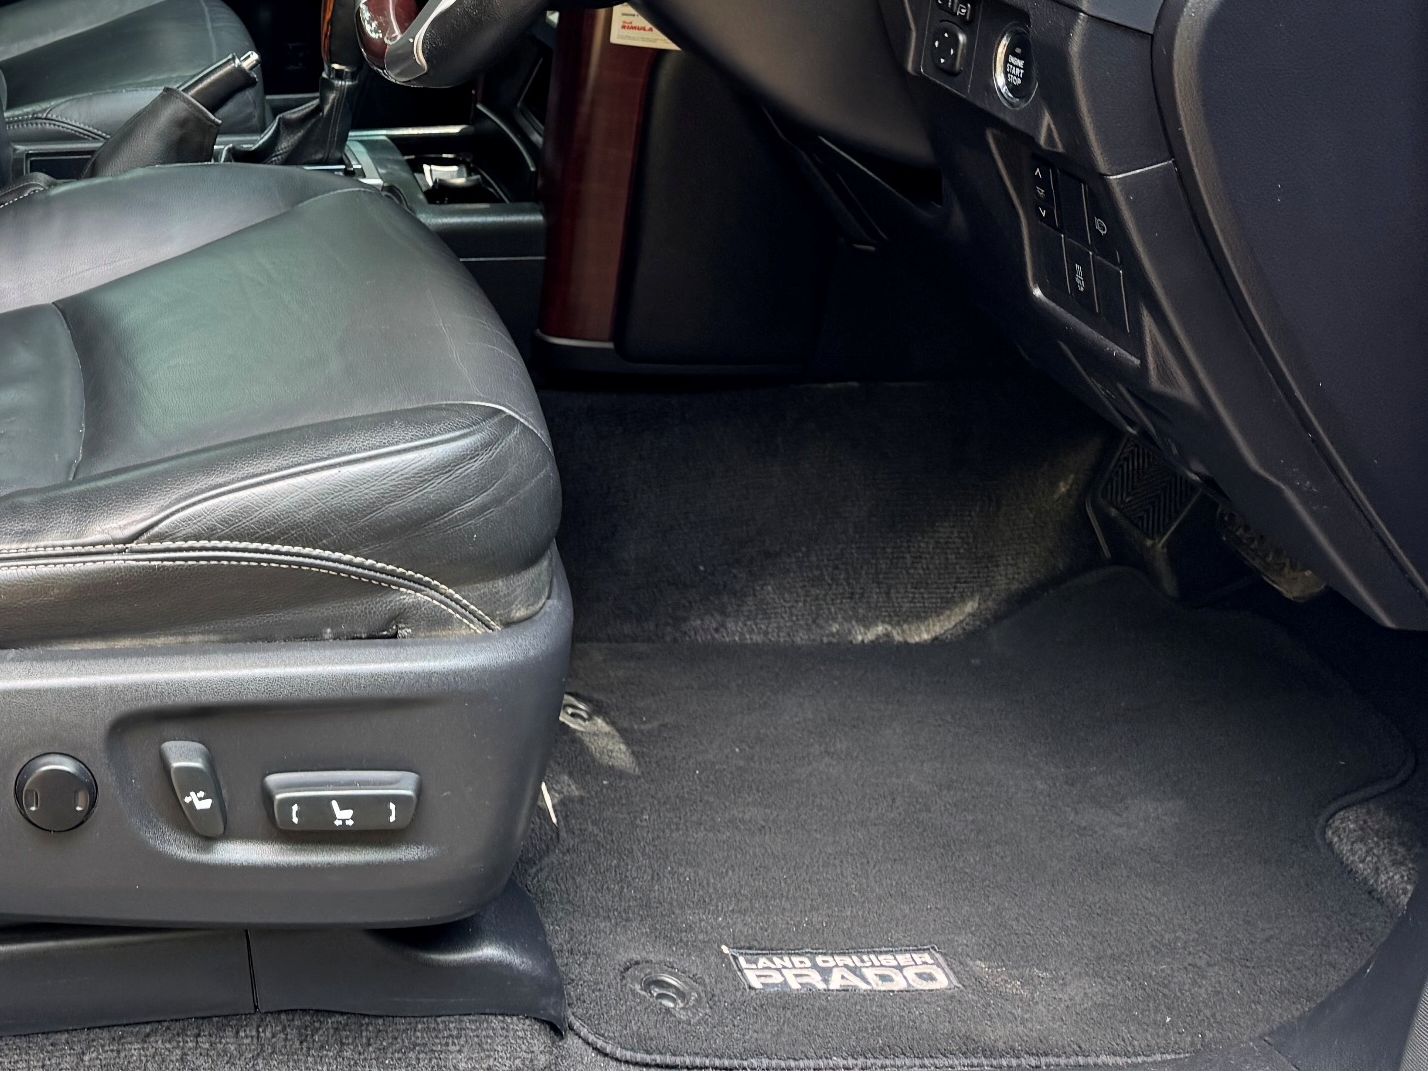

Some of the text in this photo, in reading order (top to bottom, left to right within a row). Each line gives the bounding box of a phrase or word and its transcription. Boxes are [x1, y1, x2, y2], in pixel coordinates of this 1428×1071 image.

[621, 24, 654, 32] RIMULA
[1008, 54, 1025, 68] ENGINE
[1006, 62, 1024, 78] START
[1007, 73, 1022, 85] STOP
[739, 952, 934, 969] LAND CRUISER
[743, 965, 949, 990] PRADO
